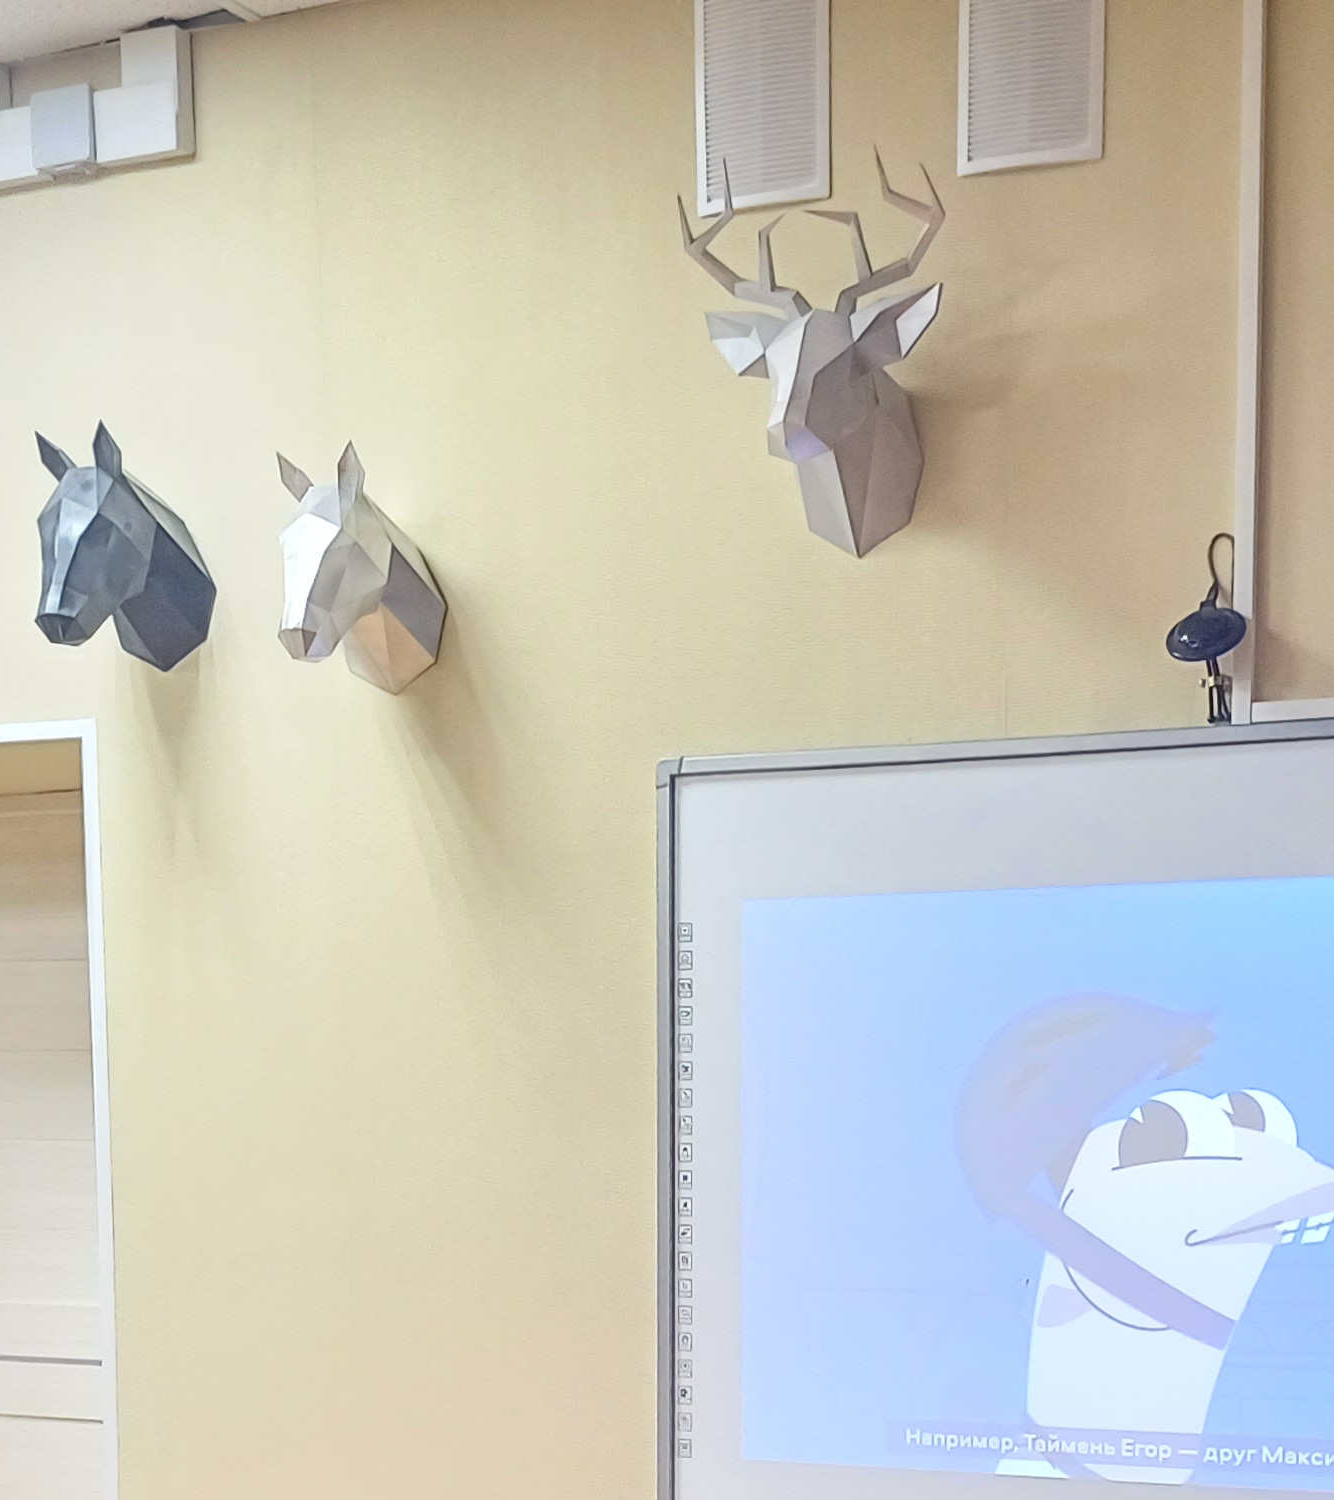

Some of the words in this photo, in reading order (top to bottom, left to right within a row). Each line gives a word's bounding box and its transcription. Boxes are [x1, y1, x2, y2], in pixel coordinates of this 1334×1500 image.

[906, 1428, 1018, 1454] Например,
[1023, 1433, 1116, 1456] Таймень
[1121, 1438, 1172, 1462] Егор
[1203, 1446, 1258, 1467] друг
